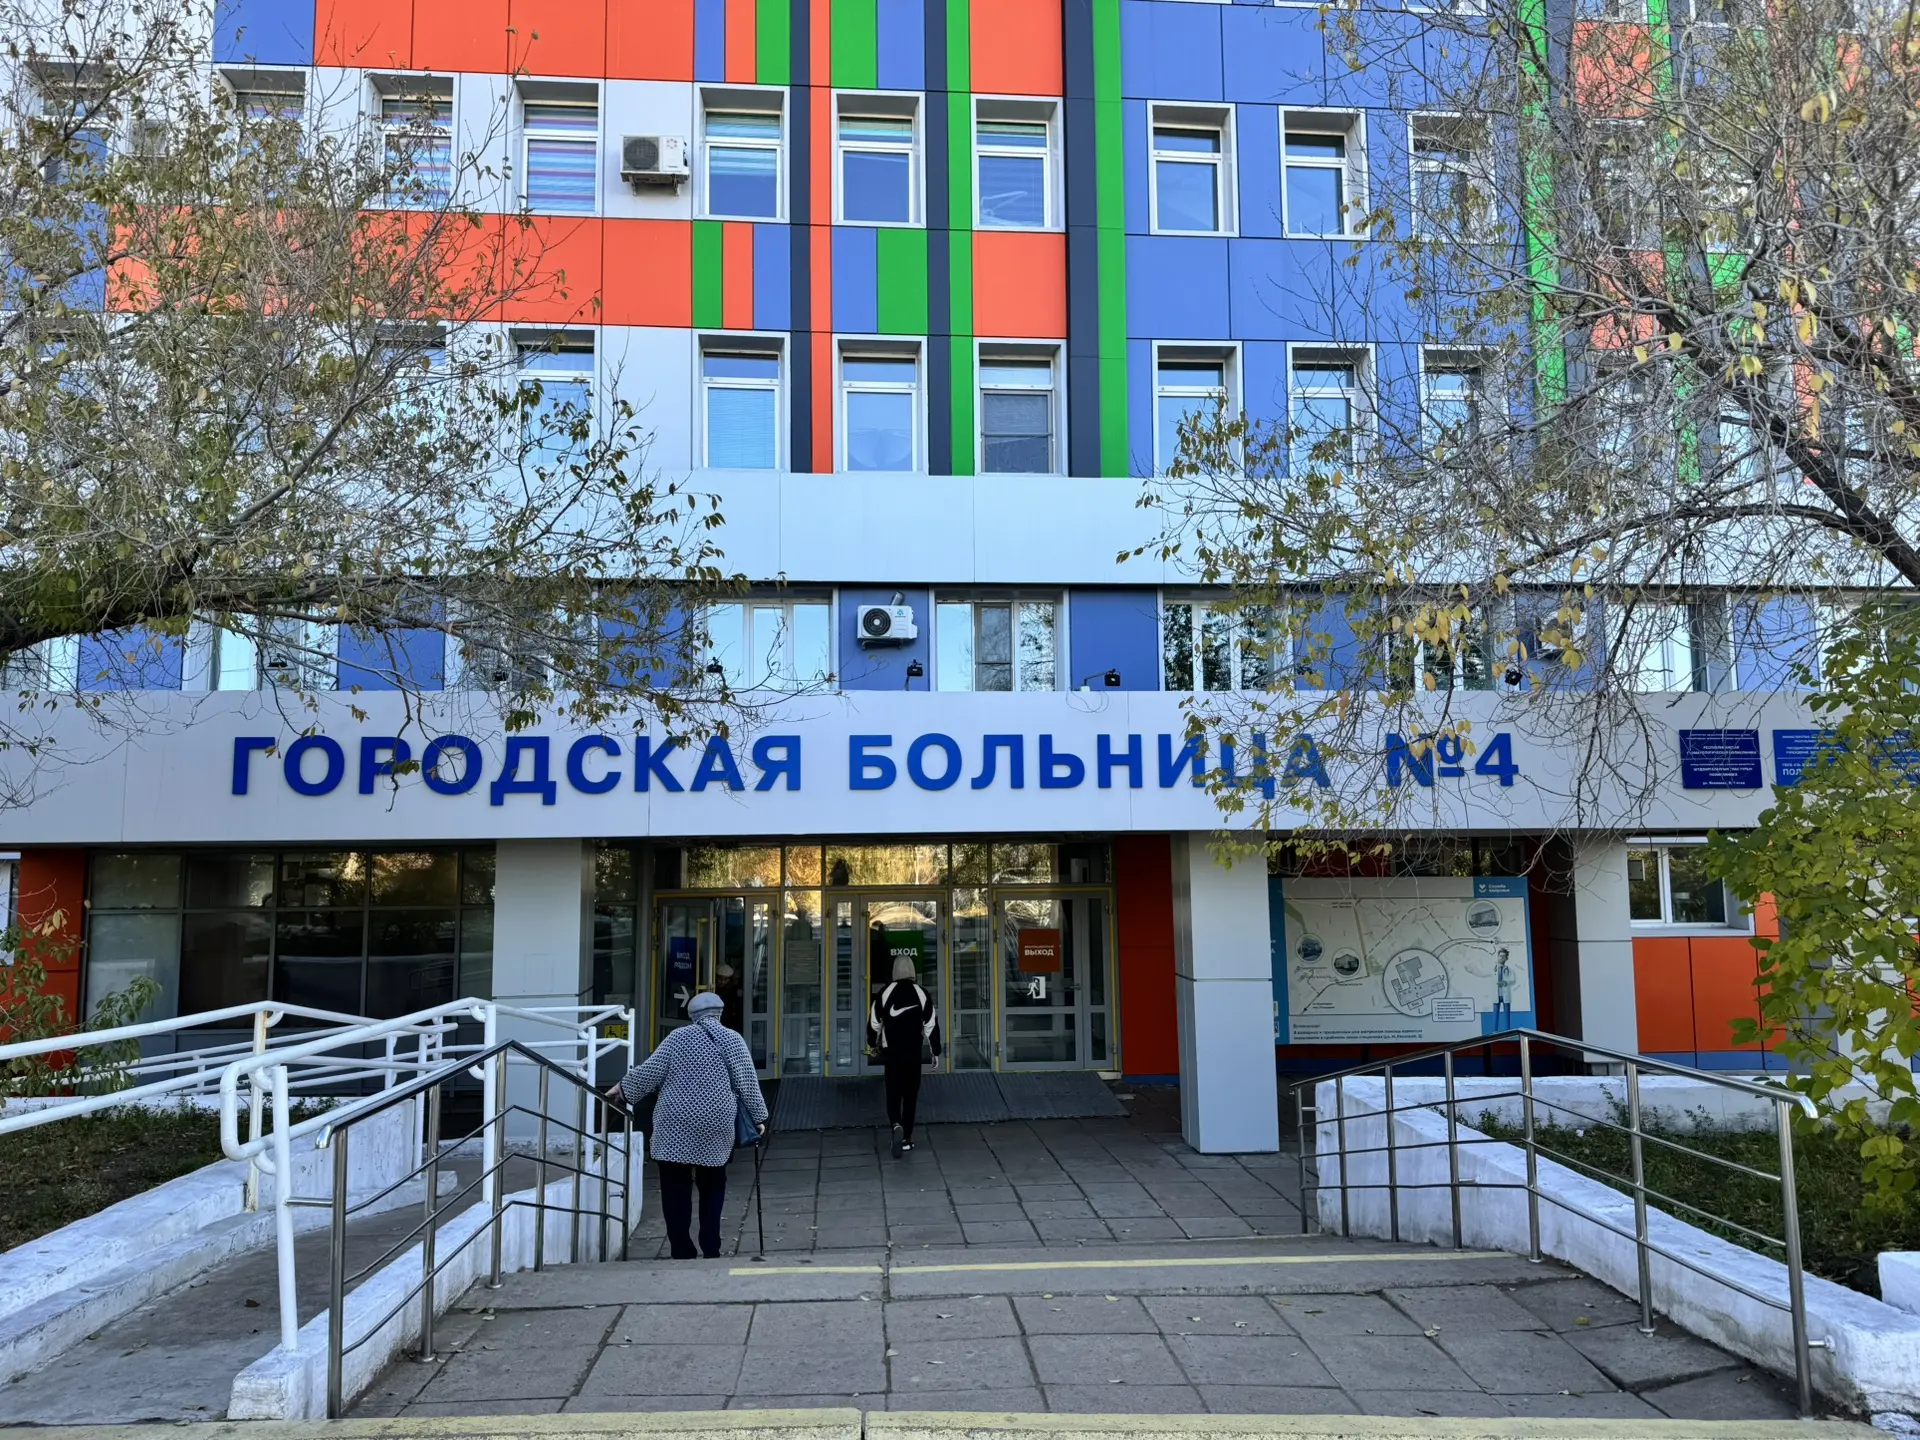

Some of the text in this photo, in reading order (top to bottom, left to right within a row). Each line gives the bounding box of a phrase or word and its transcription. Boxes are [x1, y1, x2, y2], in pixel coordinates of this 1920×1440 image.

[231, 732, 1519, 806] ГОРОДСКАЯ БОЛЬНИЦА №4
[890, 947, 918, 957] ВХОД
